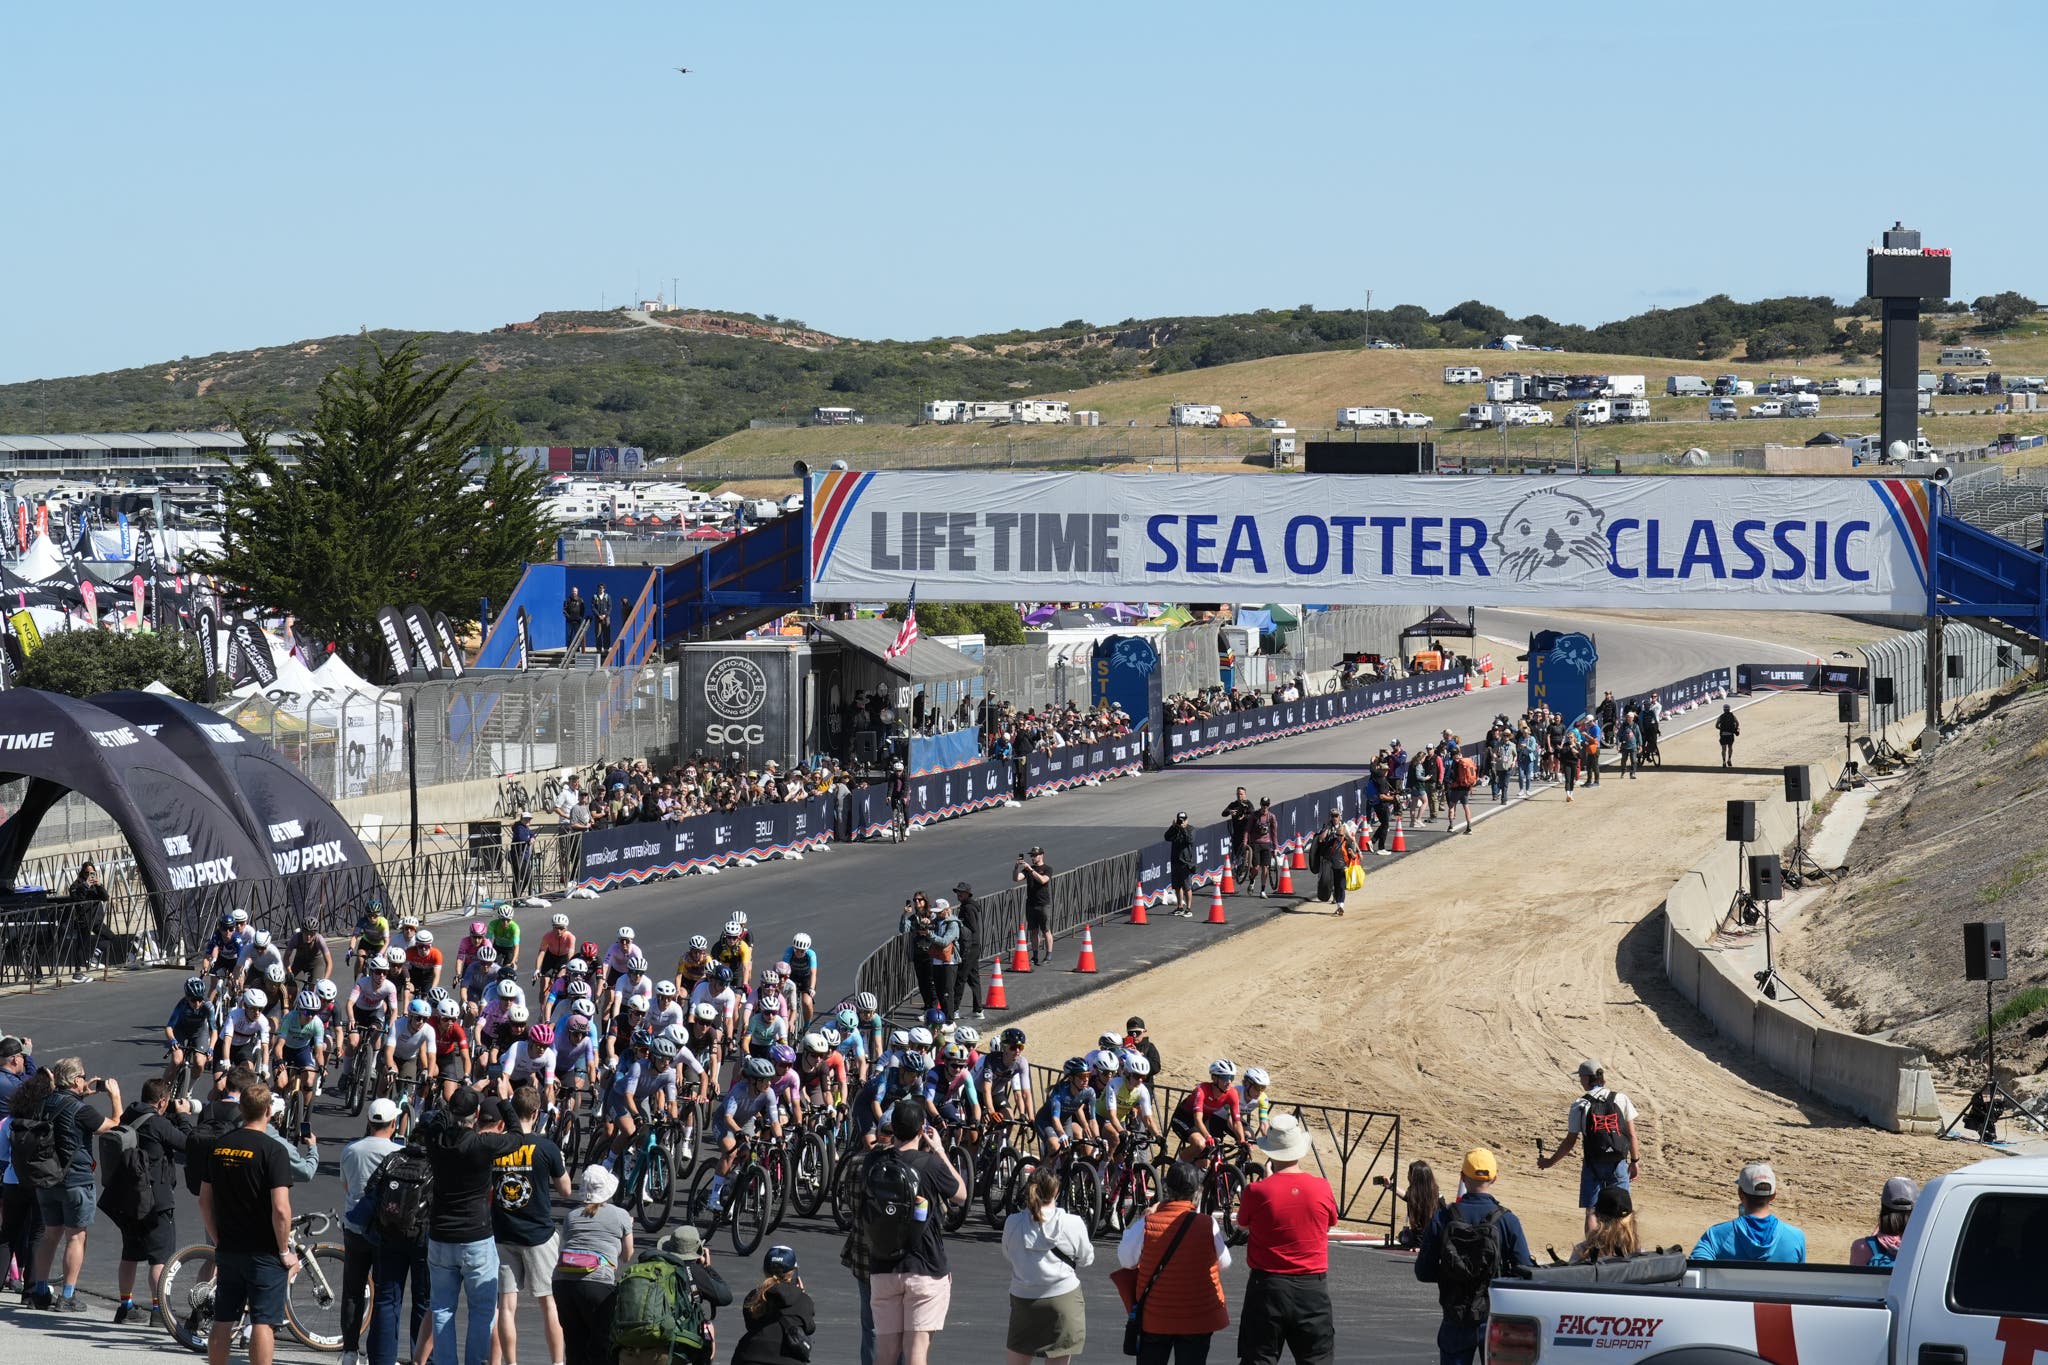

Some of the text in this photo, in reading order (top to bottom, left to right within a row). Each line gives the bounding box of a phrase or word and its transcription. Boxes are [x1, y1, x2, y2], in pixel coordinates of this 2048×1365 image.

[1872, 246, 1950, 256] WeatherTech
[871, 511, 1870, 581] LIFE TIME SEA OTTER CLASSIC
[236, 626, 252, 647] OR
[380, 616, 410, 676] LIFE TIME
[406, 614, 438, 672] LIFE TIME
[229, 638, 239, 679] FEEDBA
[250, 644, 273, 679] OUTDOOR
[711, 695, 738, 715] CYCLING
[0, 732, 54, 750] TIME
[706, 724, 764, 744] SCG
[273, 840, 347, 875] AND PRIX
[195, 856, 236, 887] PRIX
[213, 1148, 254, 1159] SRAM
[1556, 1314, 1664, 1337] FACTORY
[1596, 1338, 1652, 1350] SUPPORT
